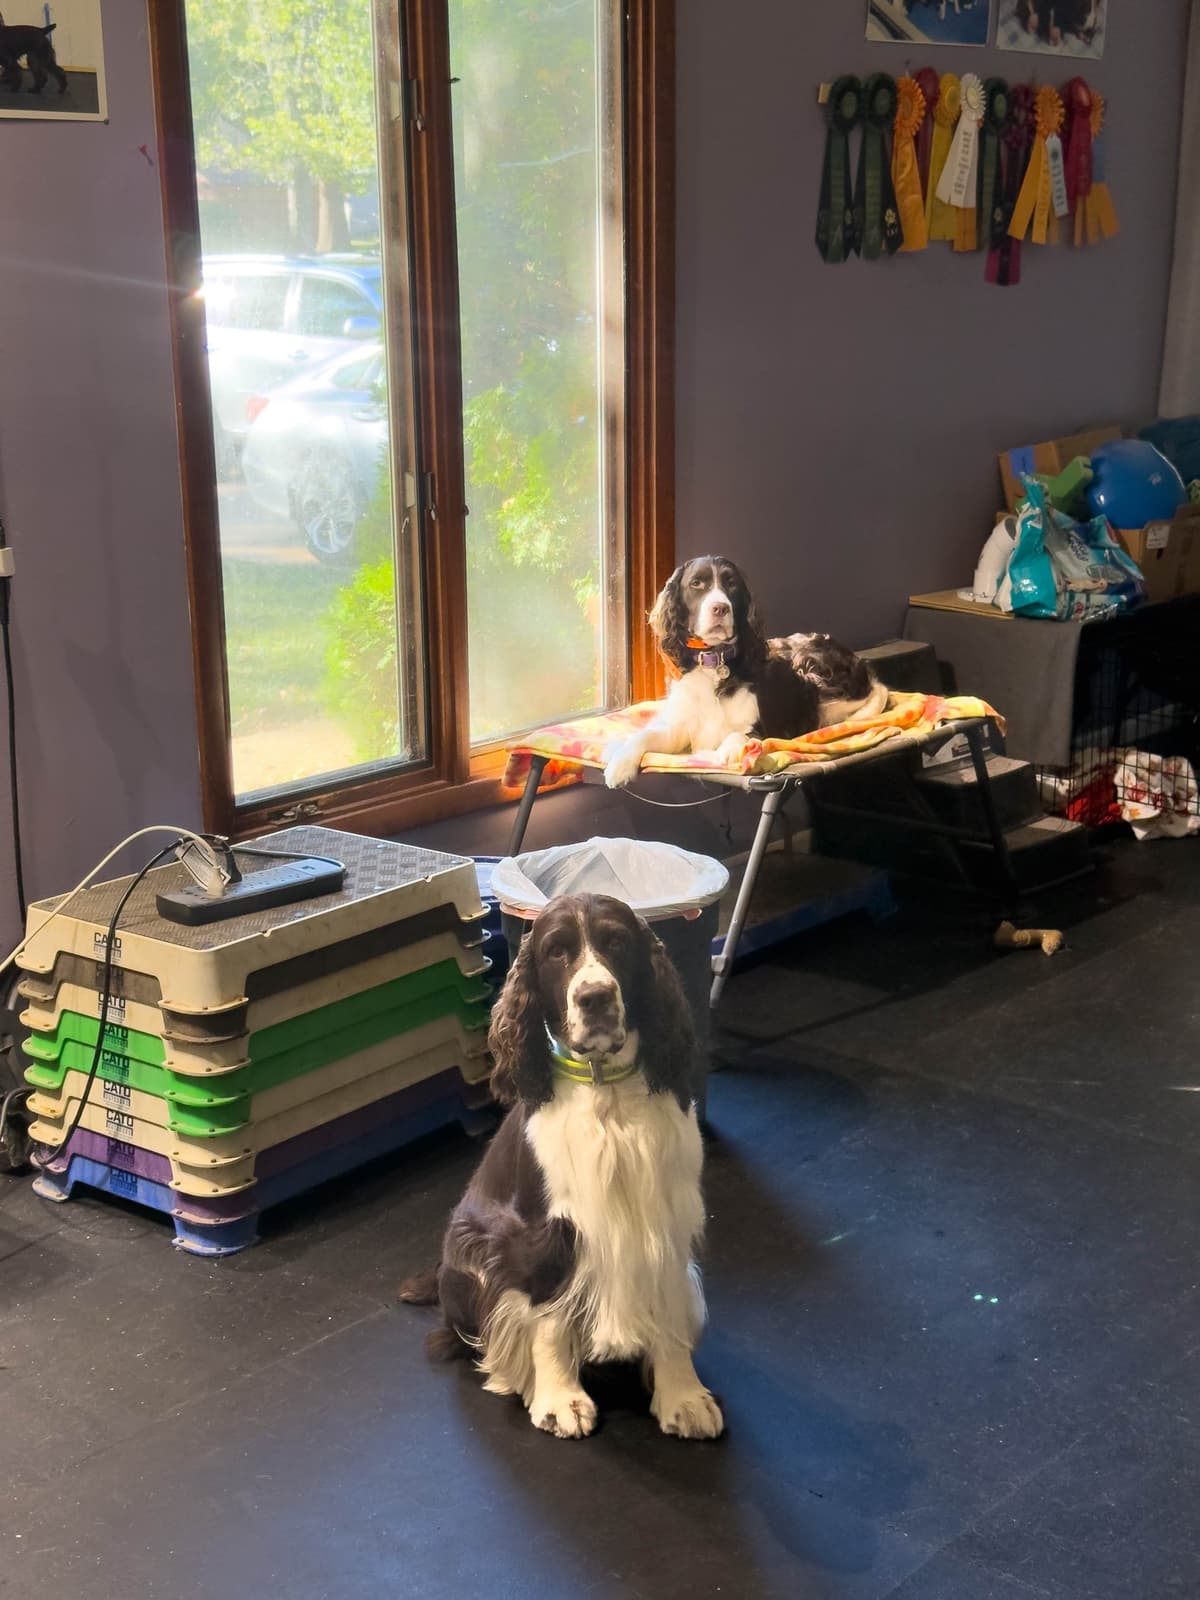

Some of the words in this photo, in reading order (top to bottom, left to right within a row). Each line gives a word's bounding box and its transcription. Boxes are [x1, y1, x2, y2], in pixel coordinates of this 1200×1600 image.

[94, 932, 122, 949] CAO
[102, 1049, 130, 1068] CATO
[104, 1080, 131, 1098] CATO
[106, 1109, 134, 1127] CATO
